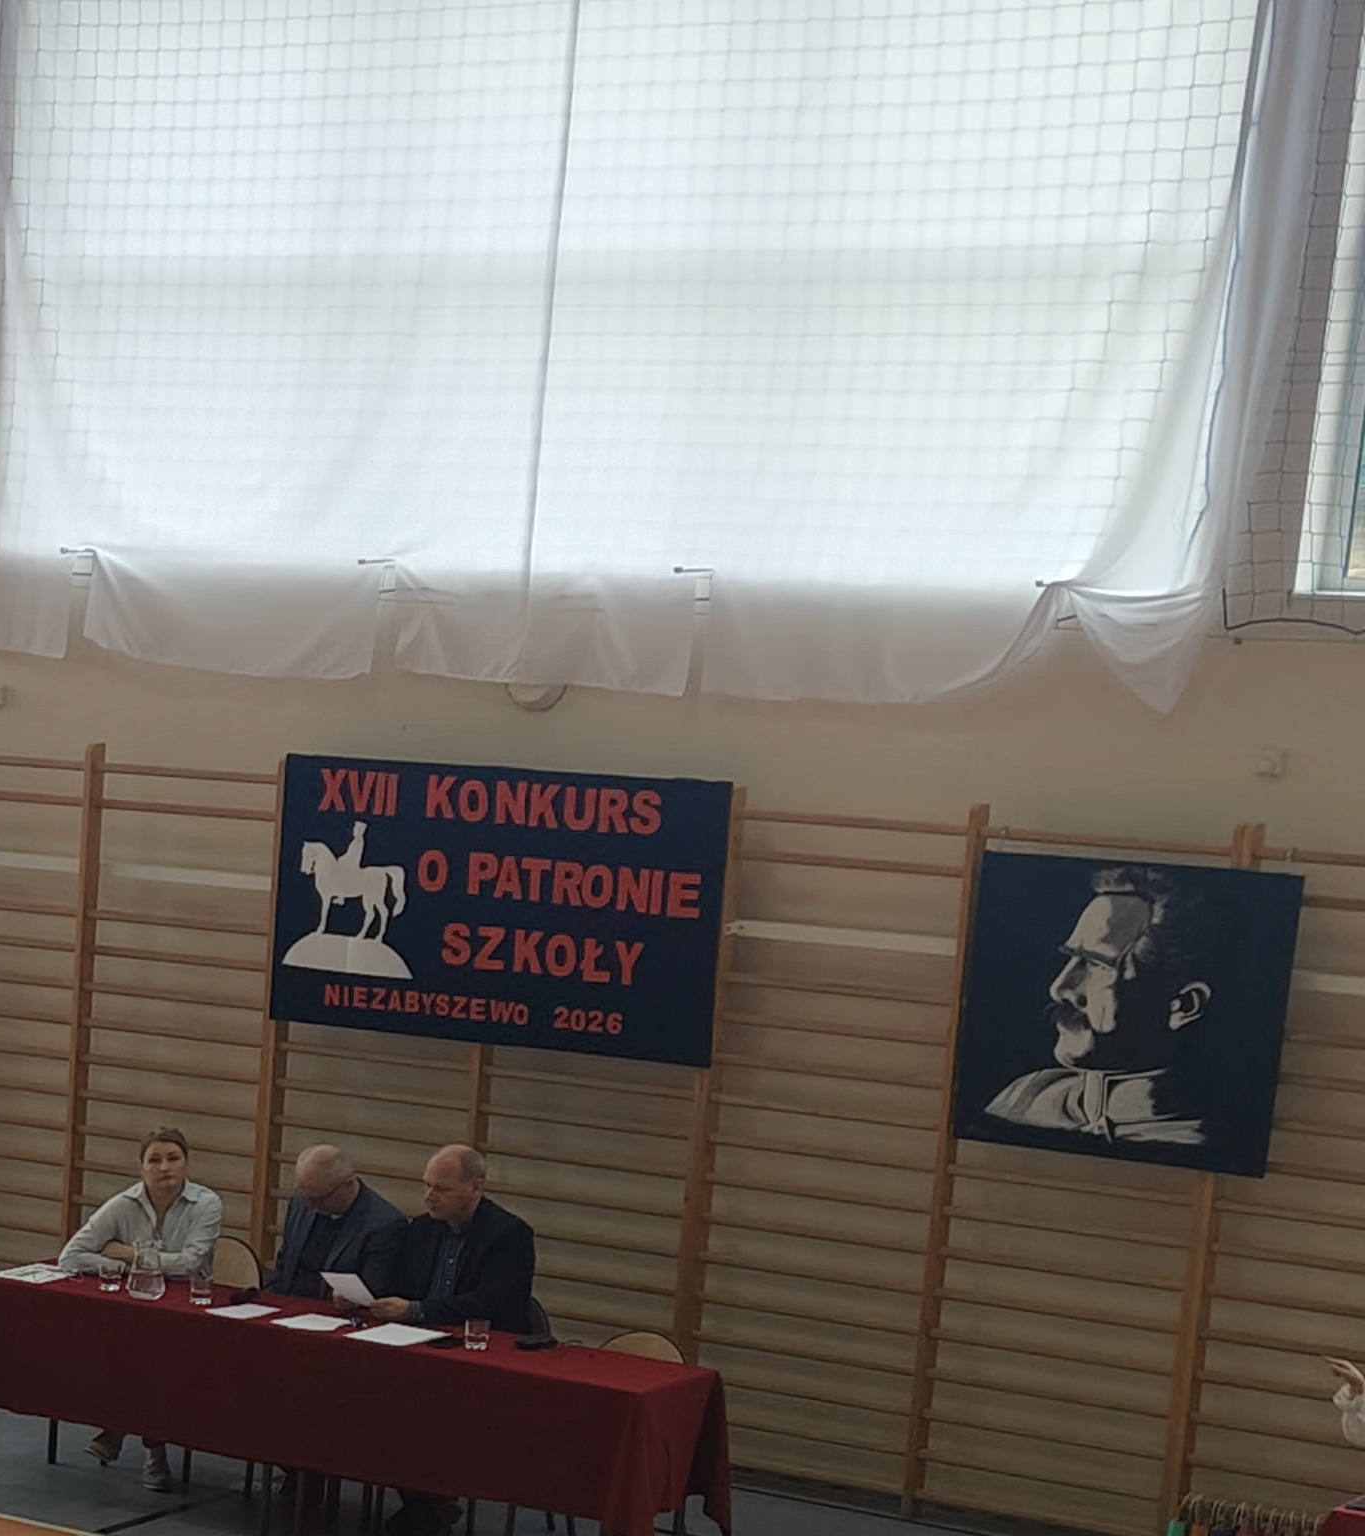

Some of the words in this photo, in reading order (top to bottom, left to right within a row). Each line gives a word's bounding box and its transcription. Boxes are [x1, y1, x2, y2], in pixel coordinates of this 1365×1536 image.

[318, 768, 398, 817] XVII
[425, 774, 662, 834] KONKURS
[417, 850, 448, 893] O
[468, 852, 702, 919] PATRONIE
[441, 923, 643, 985] SZKOŁY
[324, 984, 529, 1025] NIEZABYSZEWO
[554, 1006, 623, 1035] 2026
